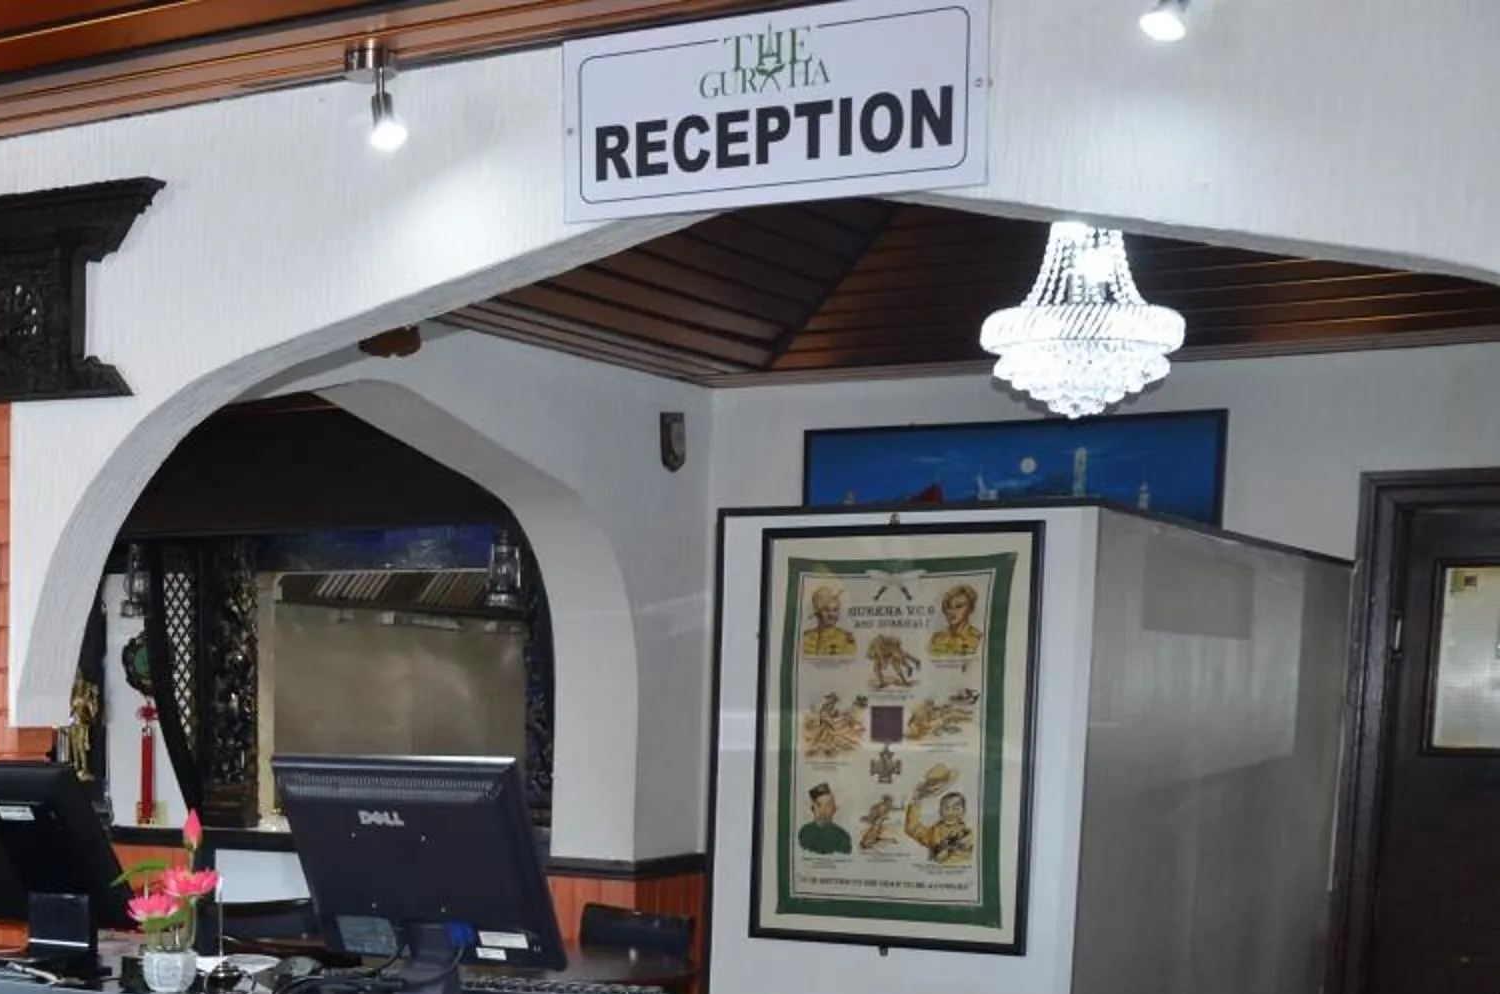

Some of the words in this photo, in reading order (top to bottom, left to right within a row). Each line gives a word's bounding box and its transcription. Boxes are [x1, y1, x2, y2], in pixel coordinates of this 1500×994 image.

[723, 26, 813, 72] THE
[595, 85, 954, 182] RECEPTION
[357, 809, 405, 827] DELL
